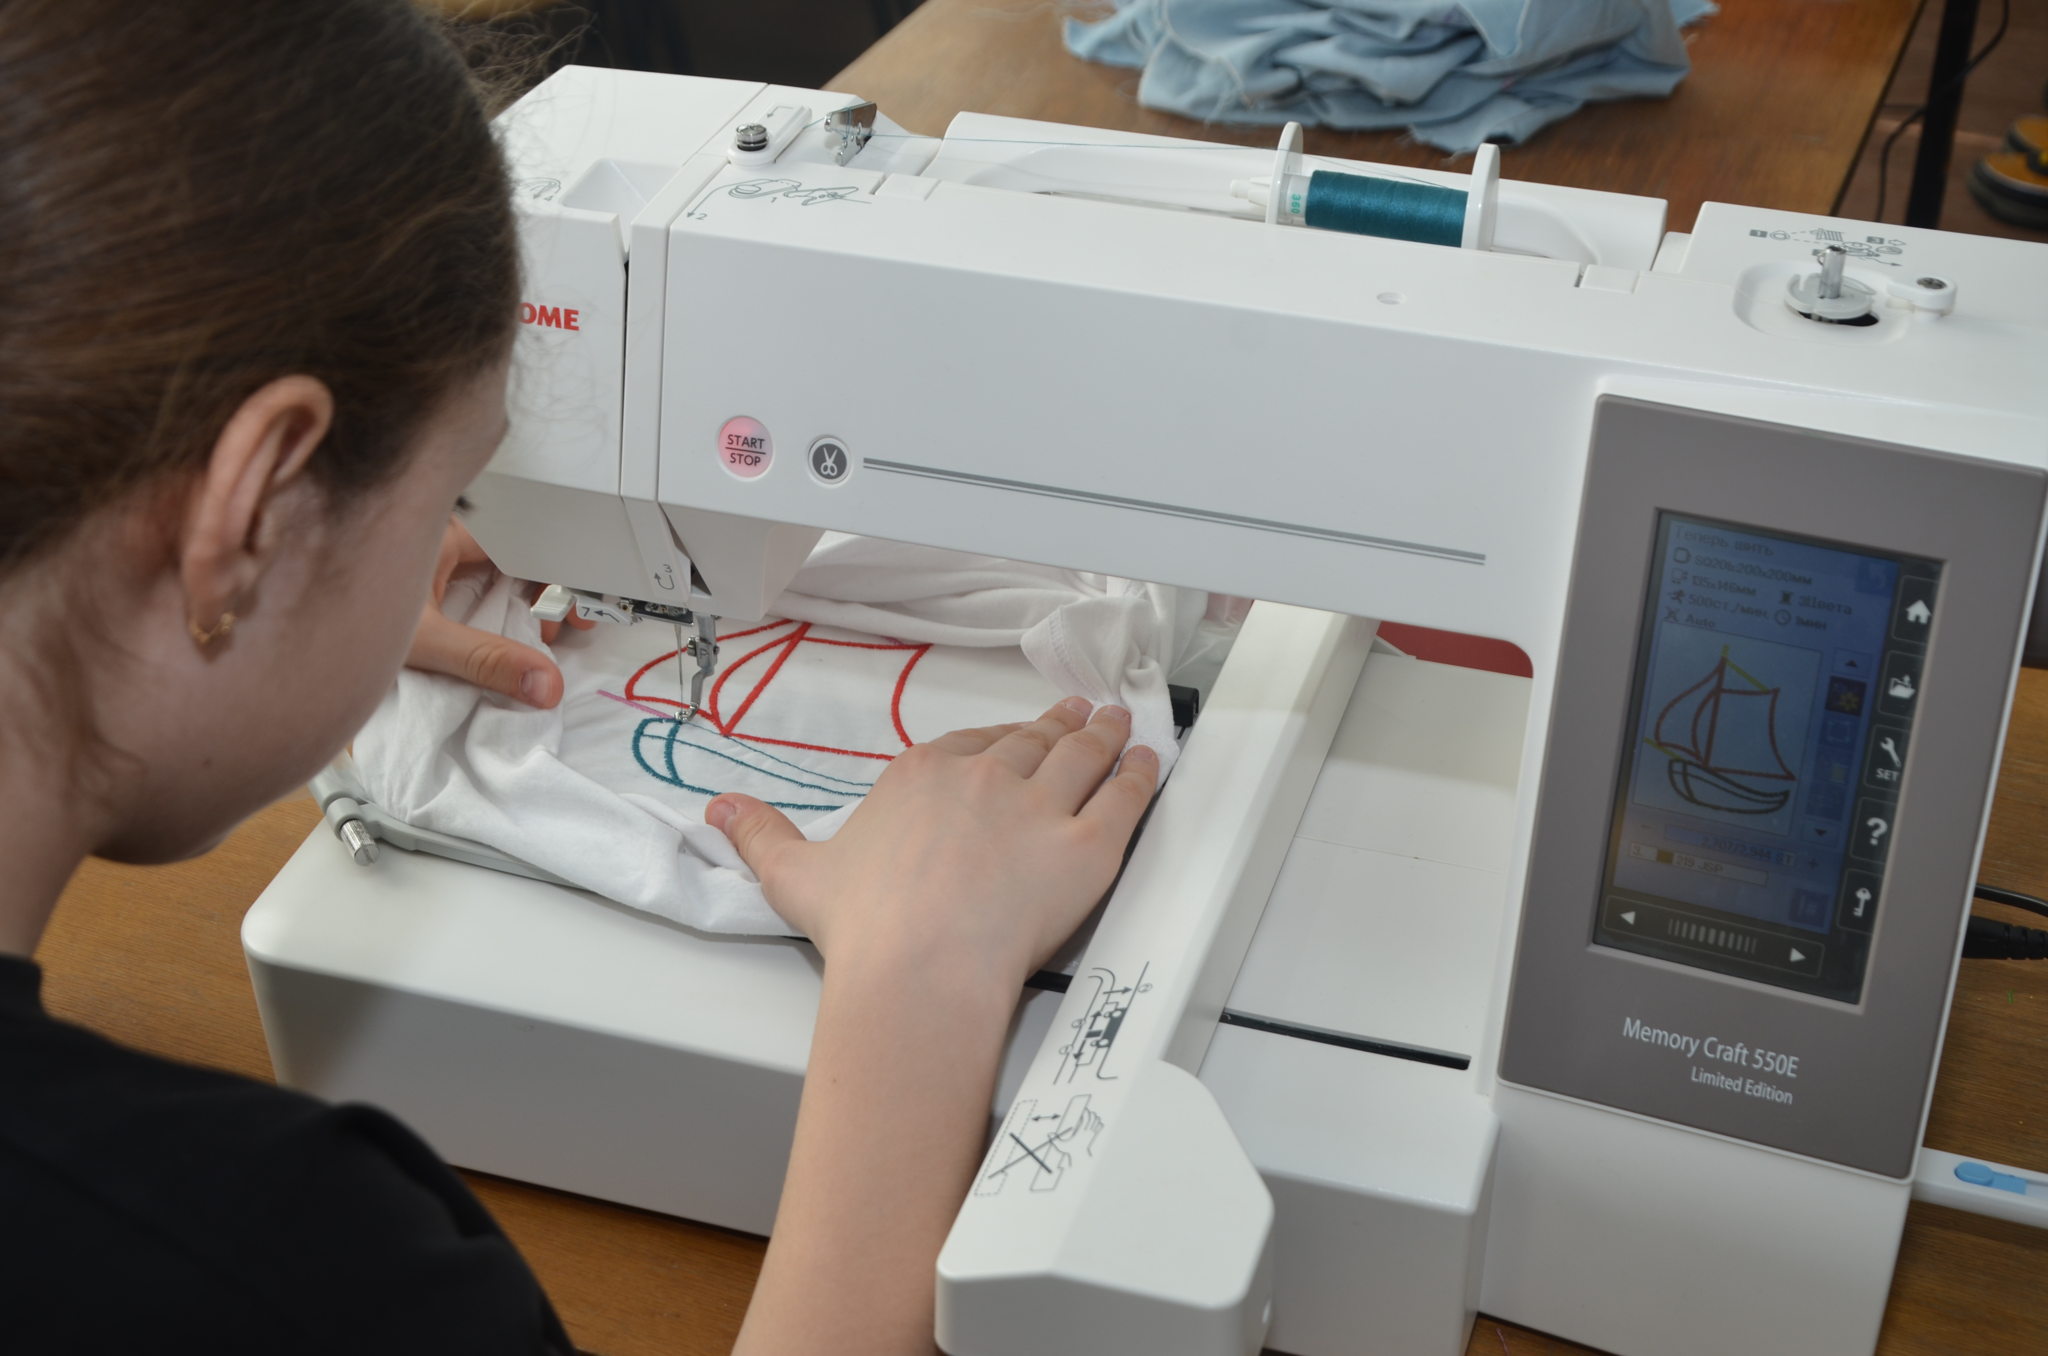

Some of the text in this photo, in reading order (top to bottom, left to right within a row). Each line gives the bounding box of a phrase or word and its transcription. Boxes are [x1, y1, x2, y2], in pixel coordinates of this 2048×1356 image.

[695, 212, 708, 221] 2
[518, 302, 580, 331] OME
[726, 433, 766, 450] START
[729, 451, 762, 467] STOP
[581, 606, 591, 617] 7
[1685, 613, 1716, 629] Auto
[1875, 767, 1900, 782] SET
[1866, 817, 1888, 845] ?
[1621, 1016, 1800, 1078] Memory Craft 550E
[1691, 1066, 1794, 1105] Limited Edition
